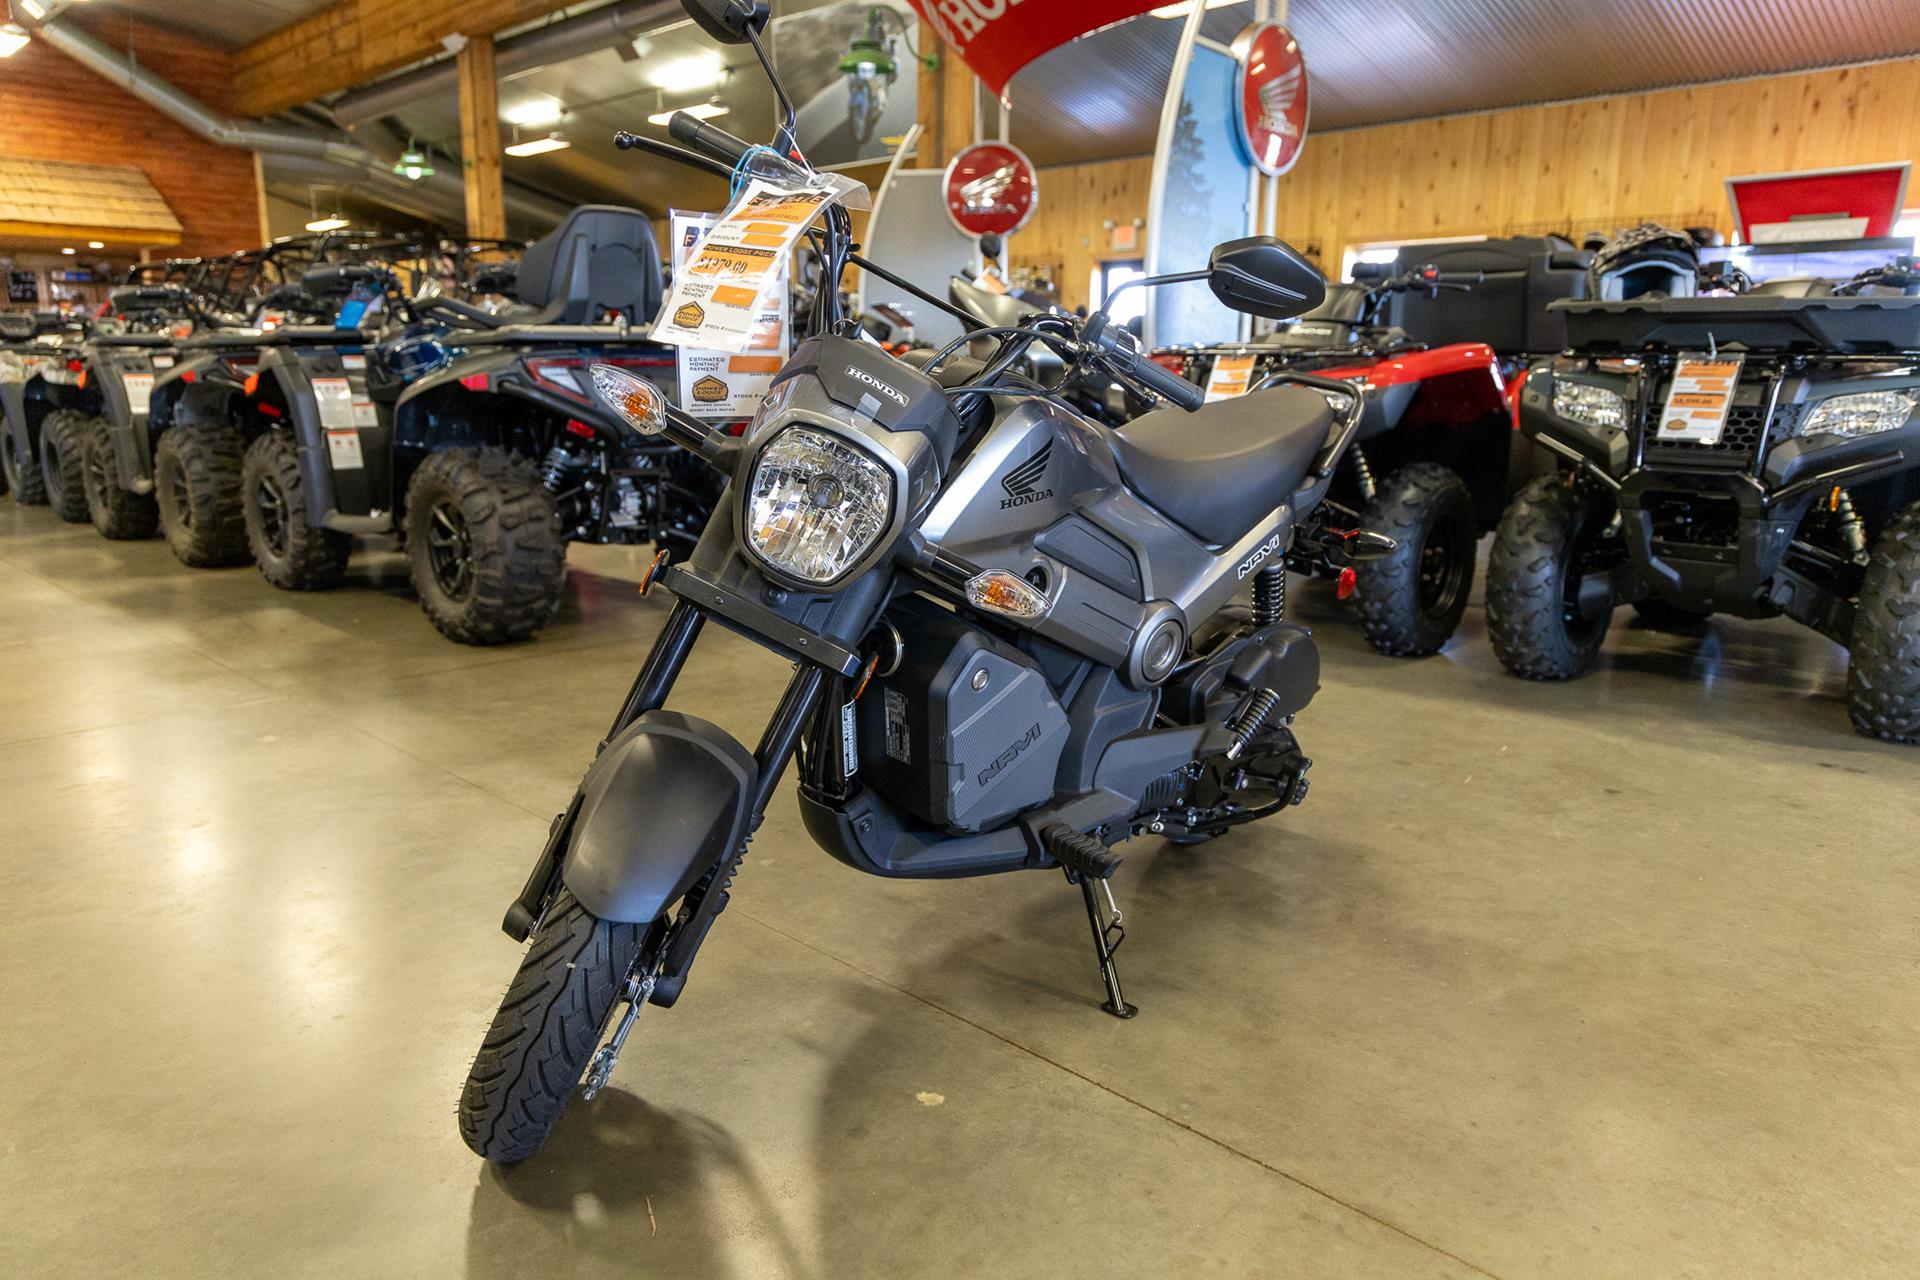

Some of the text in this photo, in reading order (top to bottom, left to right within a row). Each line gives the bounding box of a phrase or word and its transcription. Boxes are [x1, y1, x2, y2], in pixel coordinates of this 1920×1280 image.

[848, 367, 905, 405] HONDA
[1000, 488, 1054, 510] HONDA
[978, 722, 1041, 787] NAVI
